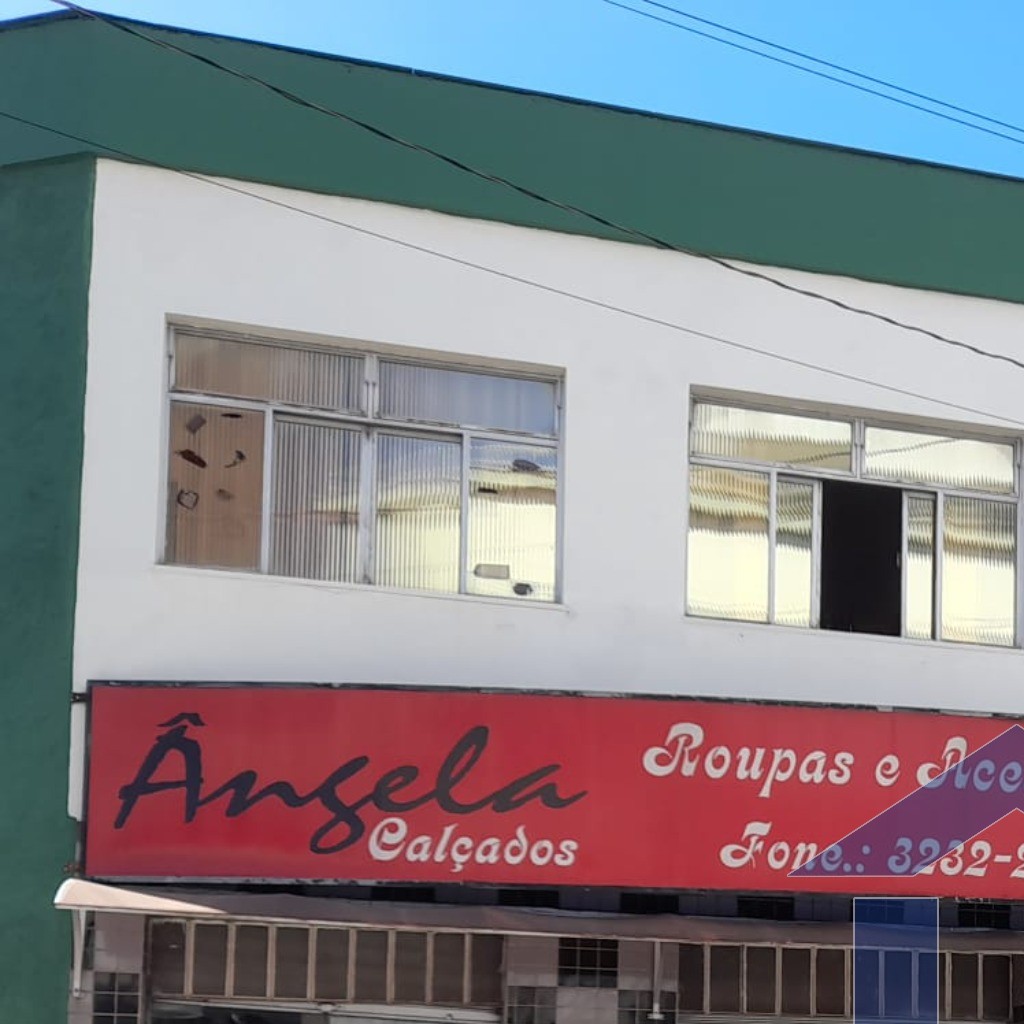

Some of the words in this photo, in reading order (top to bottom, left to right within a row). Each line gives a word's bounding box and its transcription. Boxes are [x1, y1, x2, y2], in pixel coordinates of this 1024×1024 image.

[113, 712, 588, 854] Ângela
[642, 722, 856, 798] Roupas
[875, 752, 901, 787] e
[368, 817, 579, 873] Calçados
[719, 821, 871, 874] Fone.:
